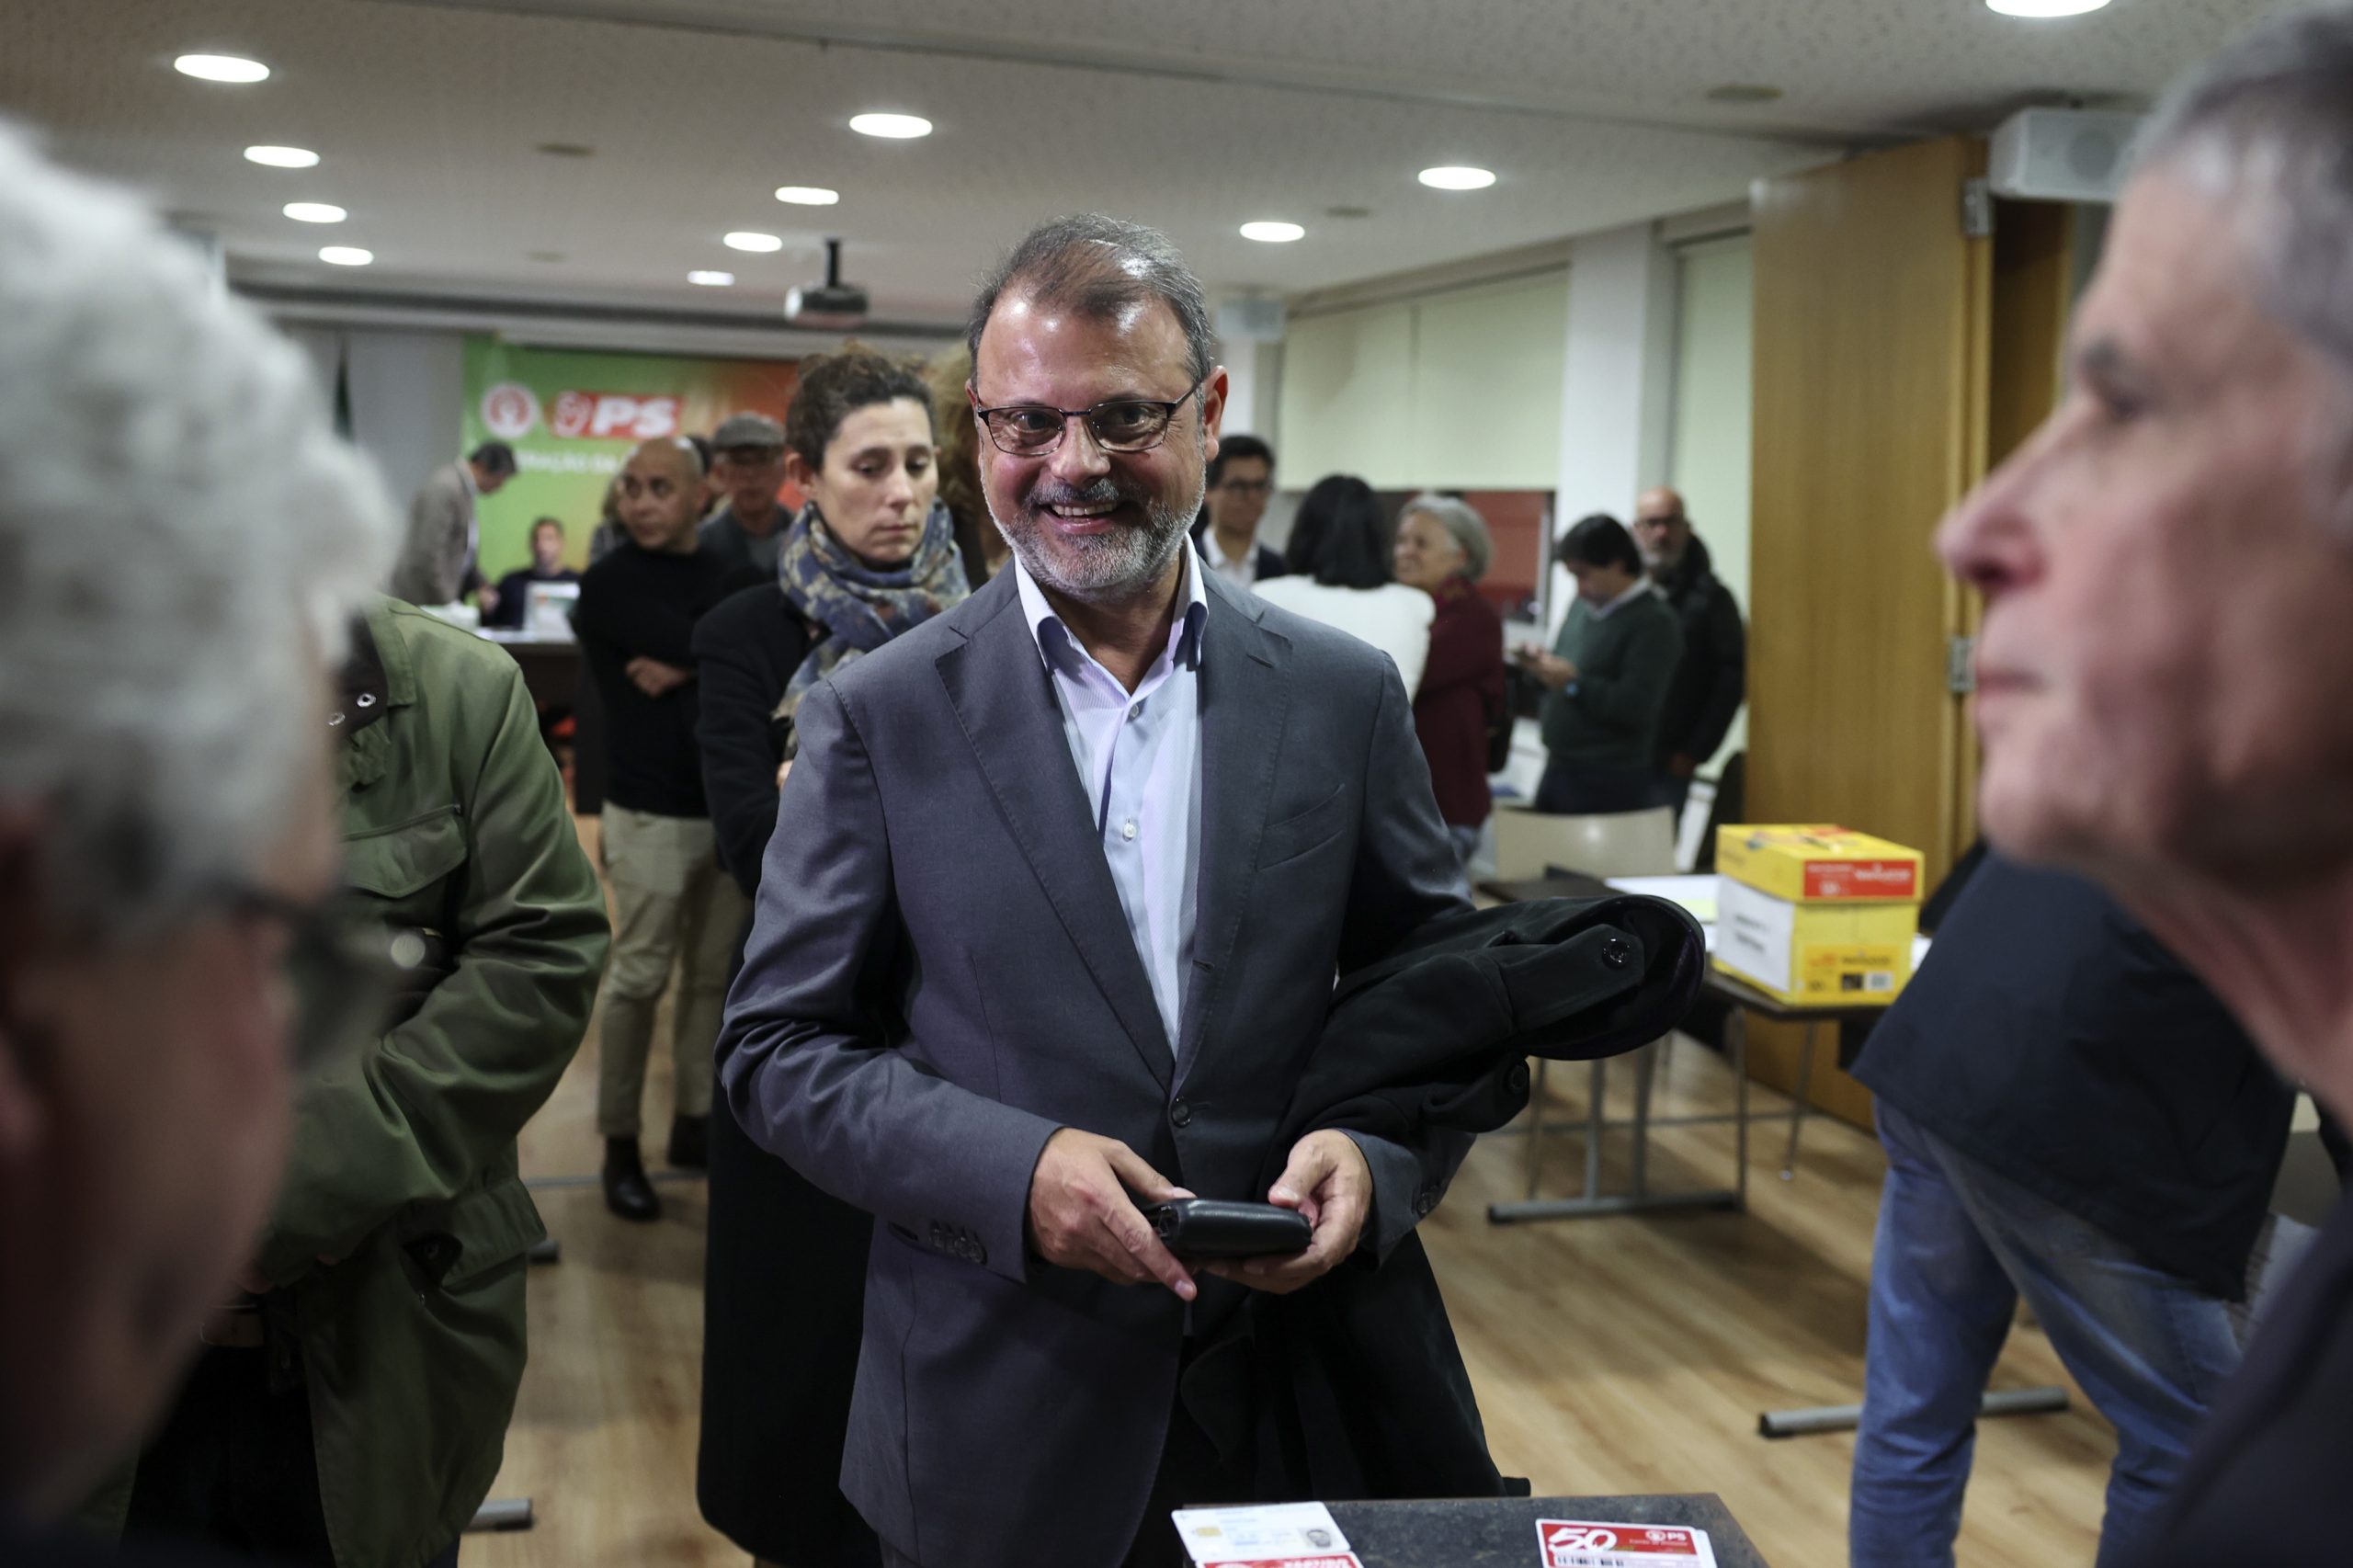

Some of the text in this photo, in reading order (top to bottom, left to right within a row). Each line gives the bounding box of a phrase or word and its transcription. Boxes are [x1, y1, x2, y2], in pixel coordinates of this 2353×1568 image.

[591, 396, 676, 438] PS
[1548, 1527, 1618, 1553] 50
[1667, 1532, 1687, 1541] PS
